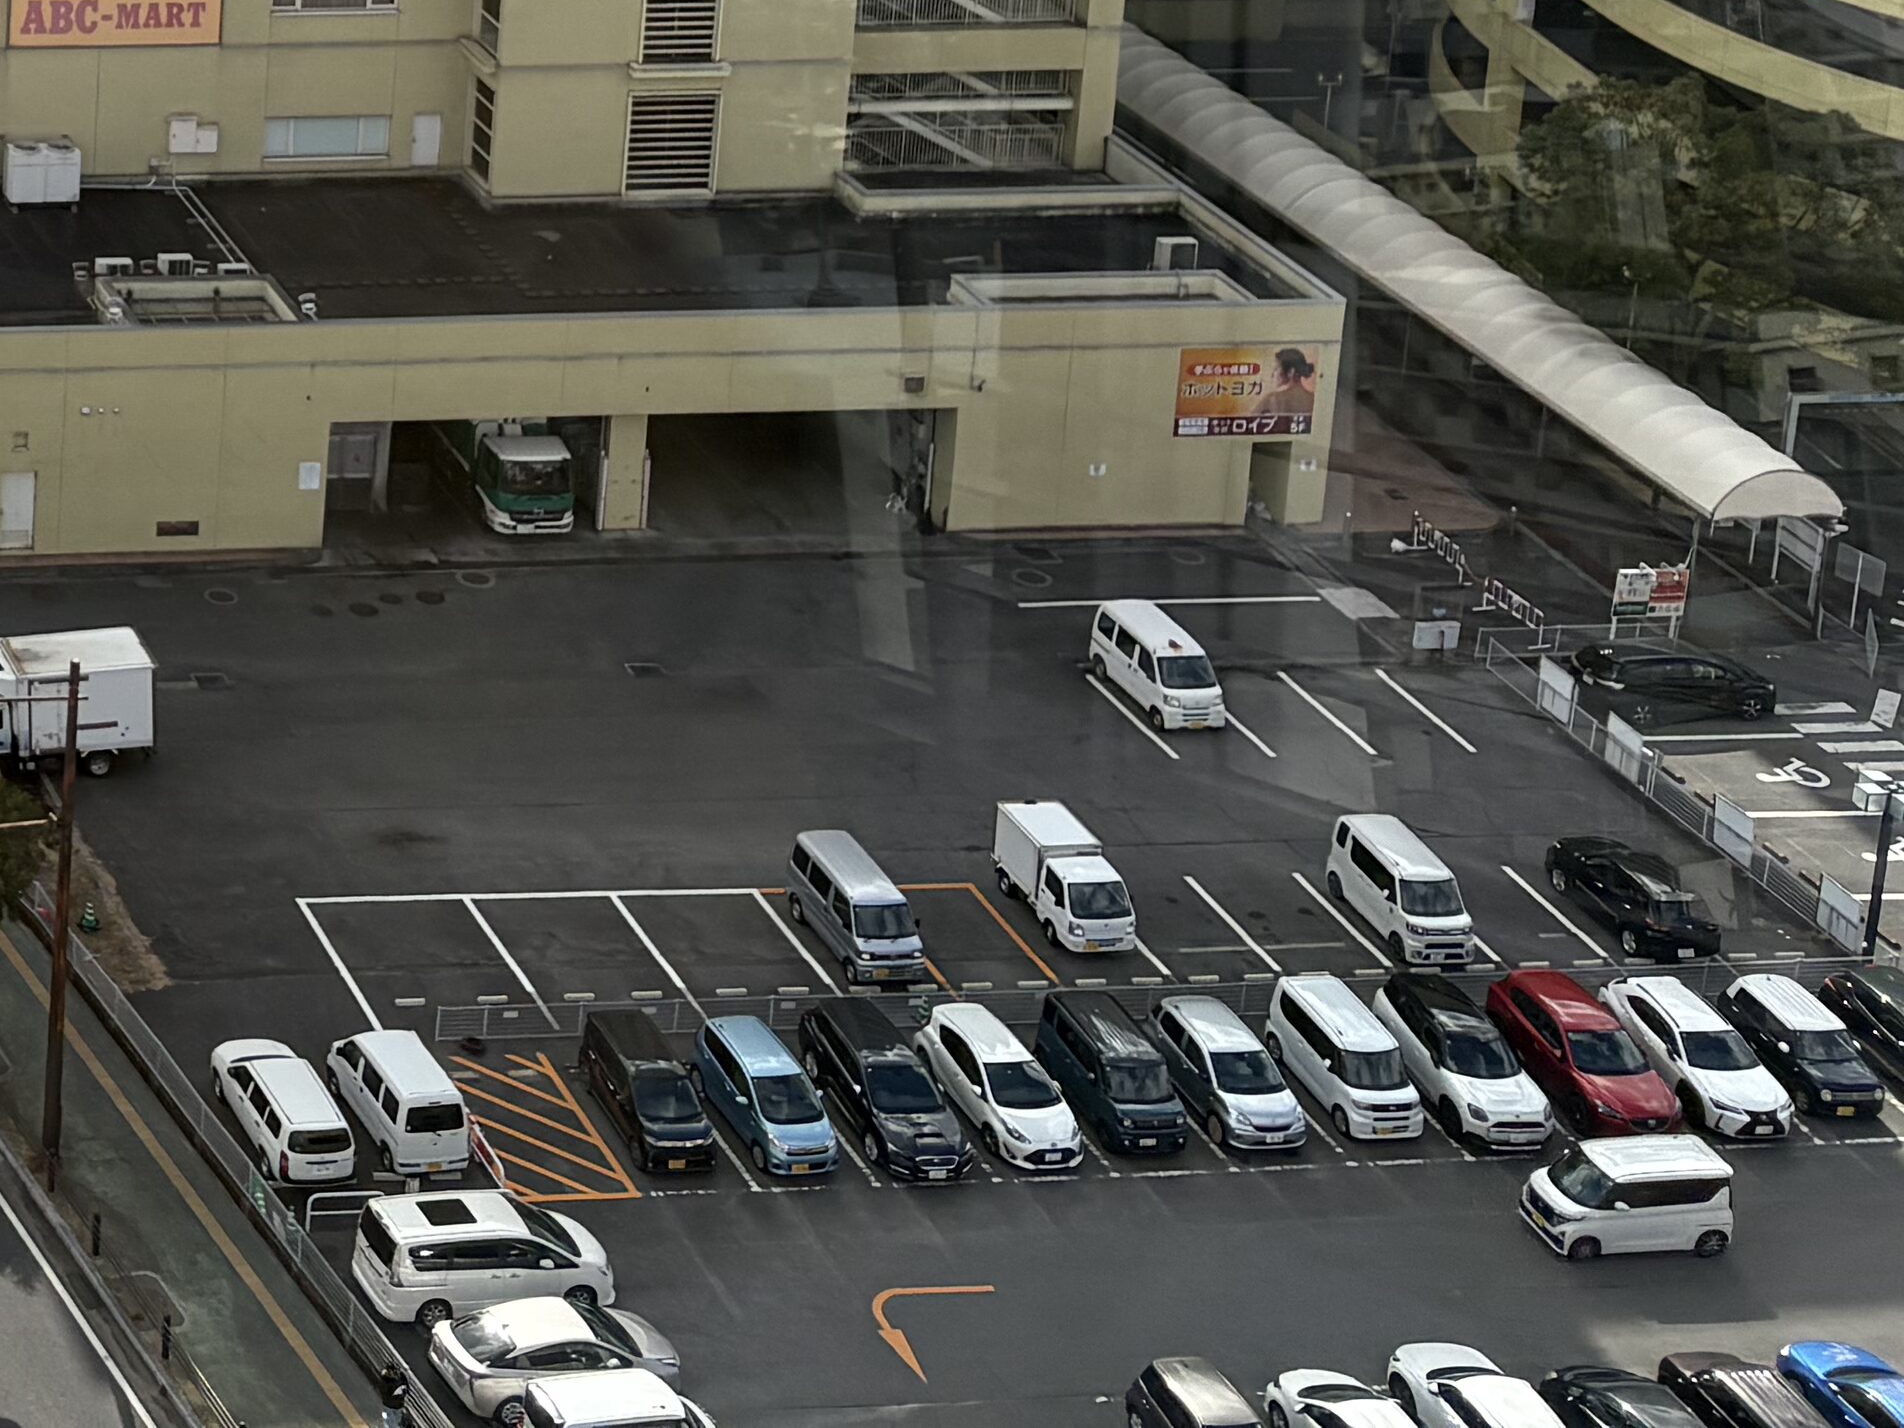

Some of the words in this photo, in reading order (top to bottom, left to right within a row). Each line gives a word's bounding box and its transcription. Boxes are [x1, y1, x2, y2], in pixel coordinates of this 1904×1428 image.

[20, 0, 206, 35] ABC-MART
[1182, 380, 1263, 396] ホットヨガ
[1232, 416, 1278, 433] ロイブ
